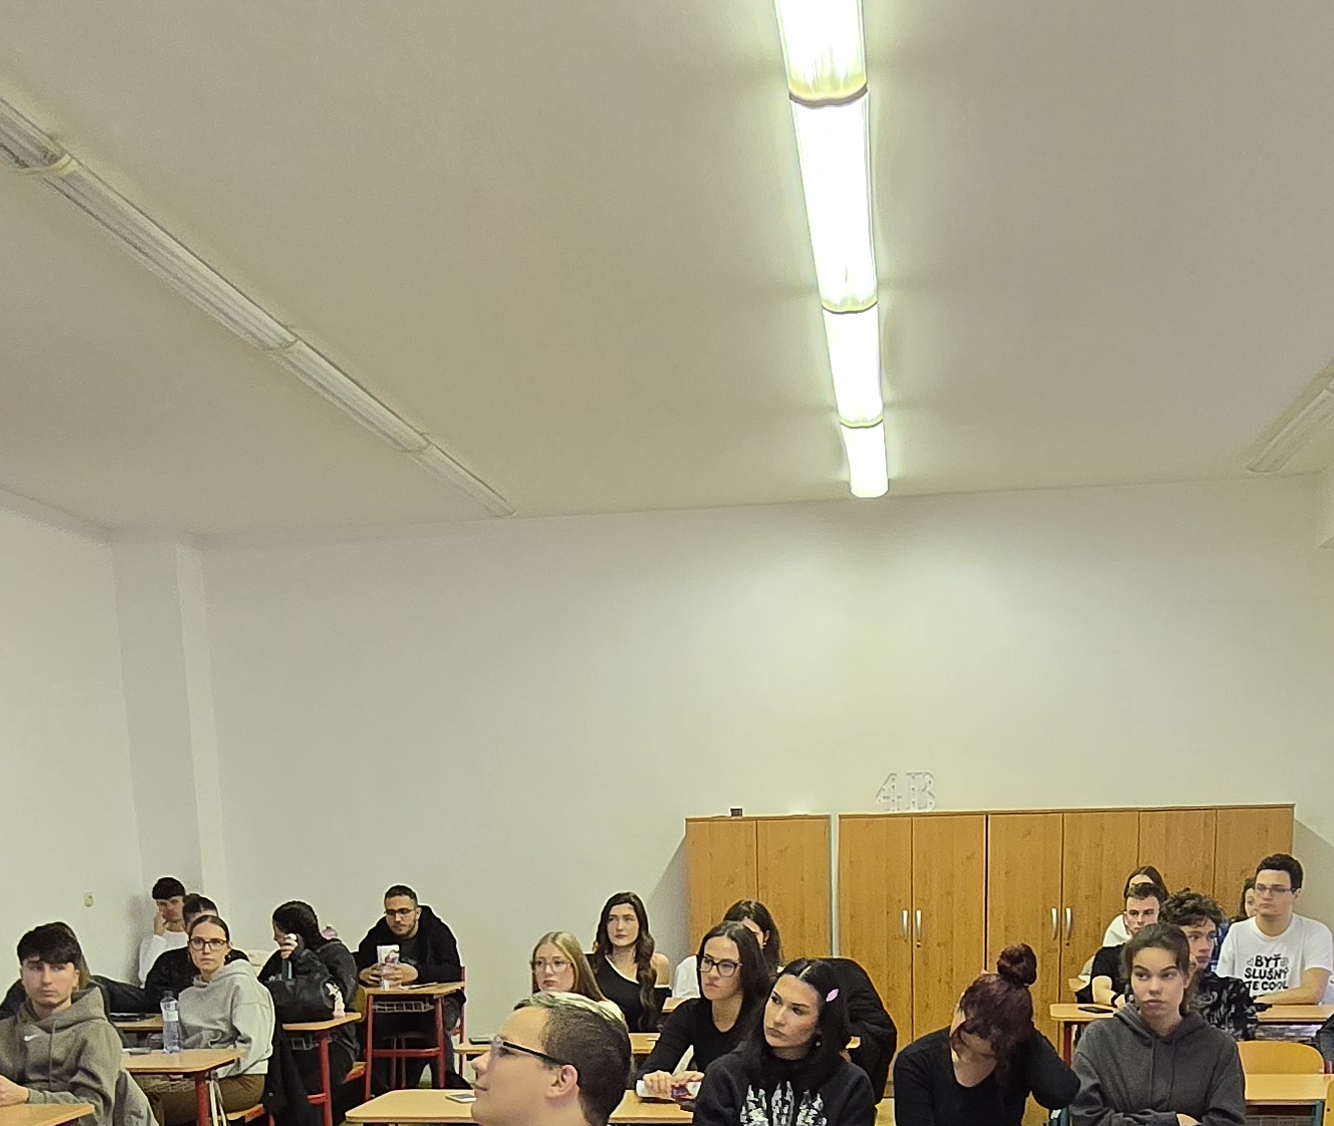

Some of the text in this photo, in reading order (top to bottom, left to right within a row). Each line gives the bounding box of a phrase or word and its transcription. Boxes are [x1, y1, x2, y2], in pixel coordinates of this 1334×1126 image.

[1254, 953, 1281, 968] BYŤ
[1244, 967, 1289, 980] SLUŠNÝ
[1261, 980, 1289, 991] COOL
